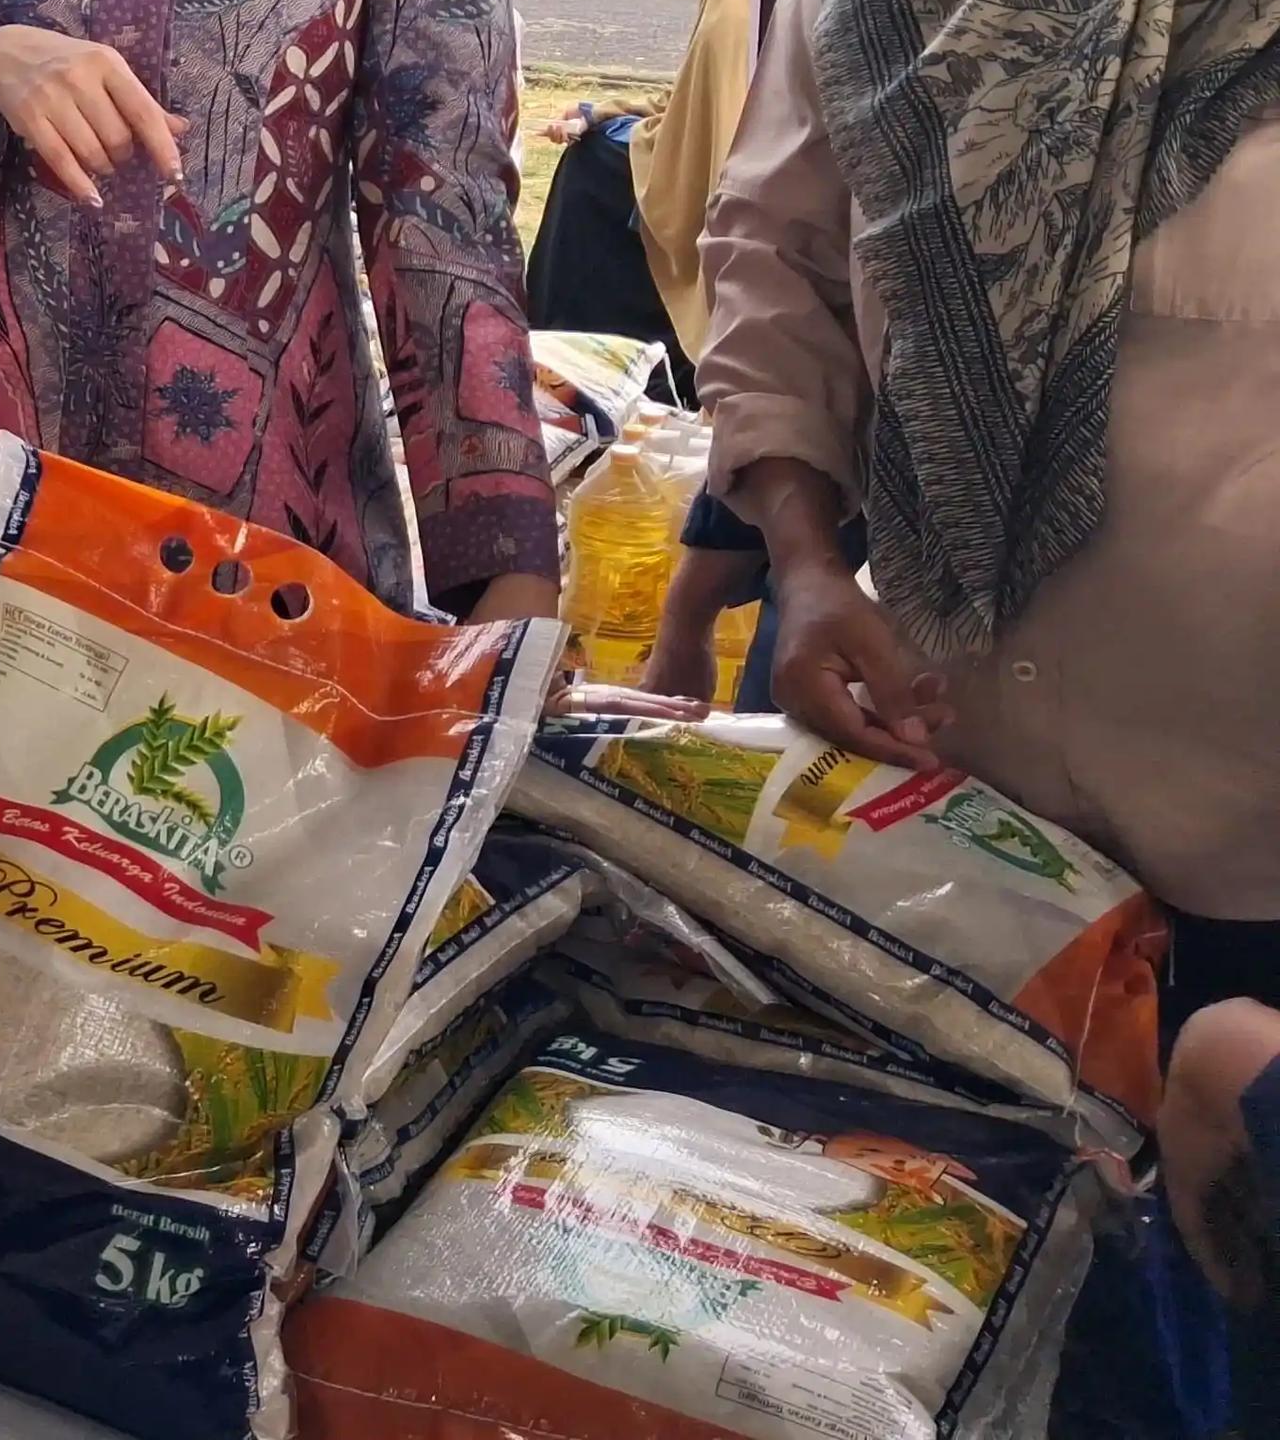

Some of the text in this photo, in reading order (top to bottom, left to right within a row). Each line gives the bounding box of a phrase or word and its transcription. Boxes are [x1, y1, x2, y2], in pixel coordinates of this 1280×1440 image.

[60, 825, 153, 885] Keluarga
[95, 1232, 205, 1309] 5 kg
